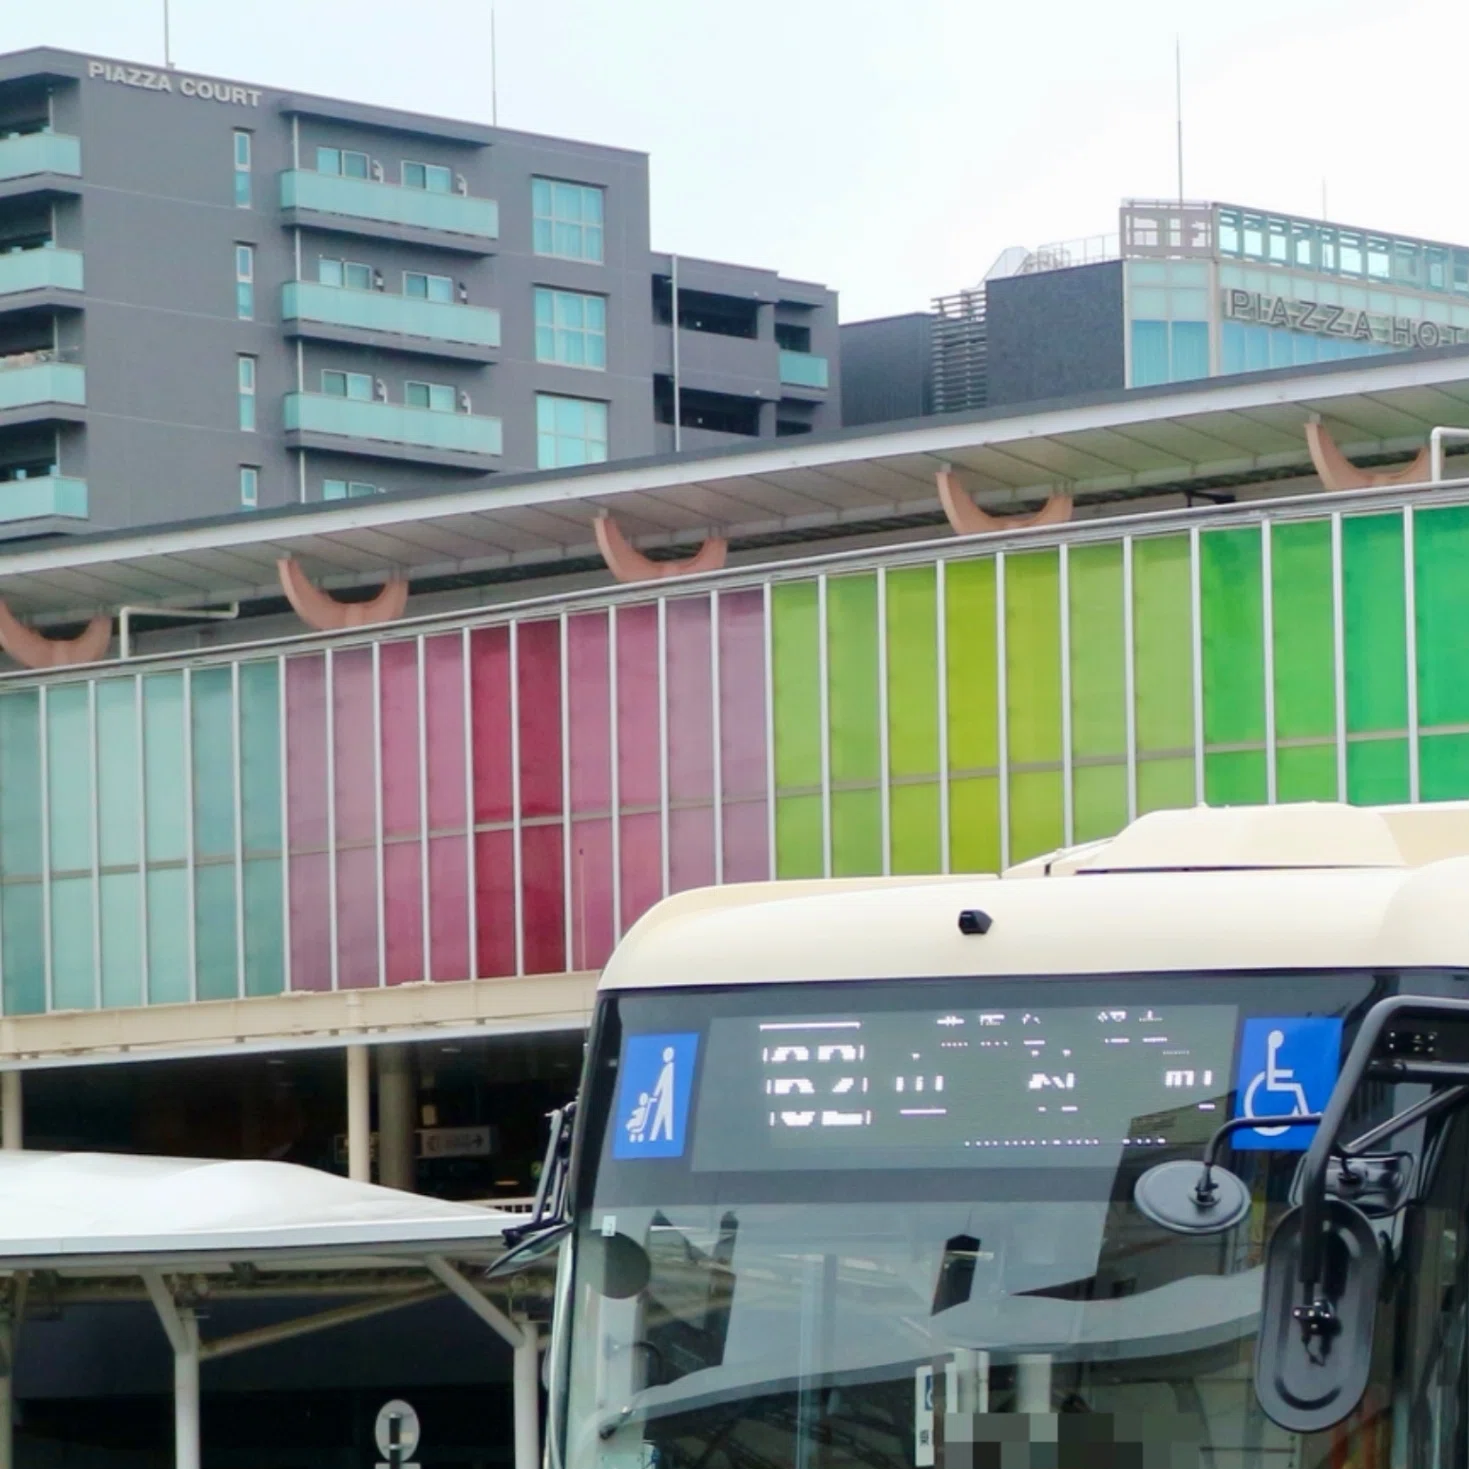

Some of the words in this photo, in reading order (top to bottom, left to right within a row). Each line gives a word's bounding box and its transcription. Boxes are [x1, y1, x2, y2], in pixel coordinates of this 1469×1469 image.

[88, 61, 173, 93] PIAZZA
[180, 78, 262, 107] COURT
[1230, 289, 1373, 340] PIAZZA
